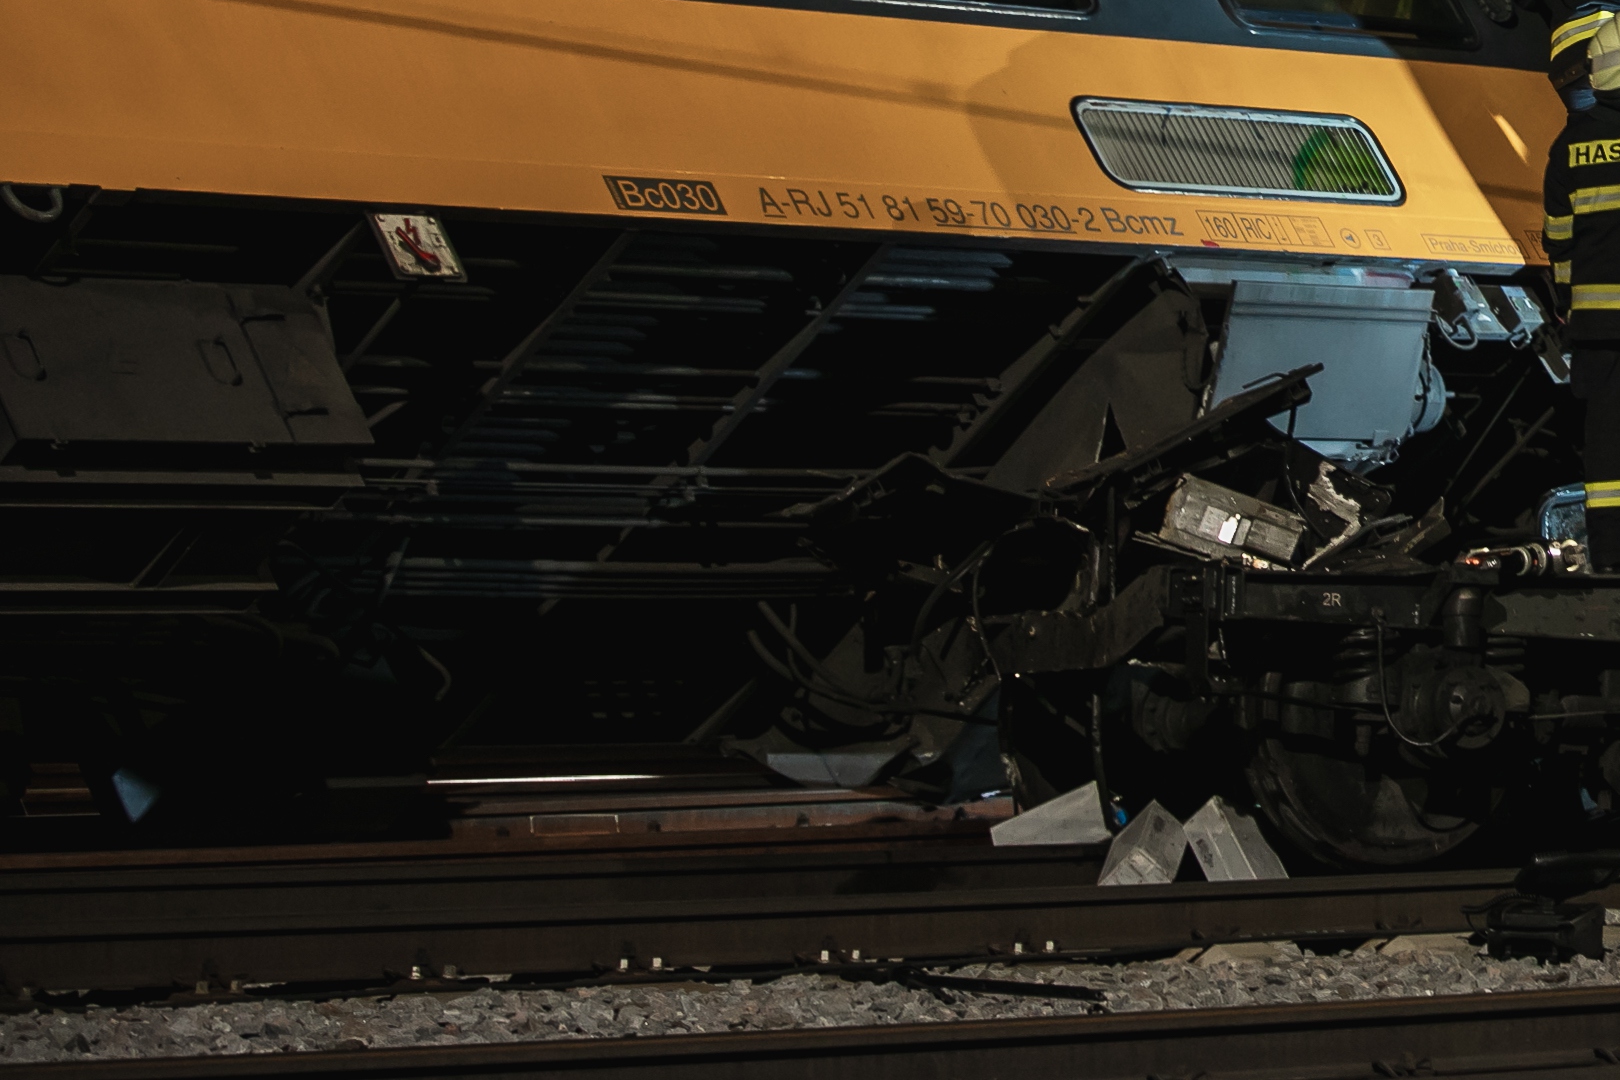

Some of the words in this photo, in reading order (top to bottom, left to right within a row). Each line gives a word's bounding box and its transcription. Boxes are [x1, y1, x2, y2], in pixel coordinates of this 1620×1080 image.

[616, 179, 720, 212] Bc030
[758, 187, 832, 218] A-RJ
[836, 192, 875, 220] 51
[881, 194, 919, 222] 81
[926, 197, 1012, 229] 59-70
[1015, 202, 1101, 232] 030-2
[1100, 206, 1185, 237] Bcmz
[1204, 216, 1238, 239] 160
[1239, 216, 1272, 240] RIC
[1371, 233, 1384, 248] 3
[1322, 592, 1342, 607] 2R
